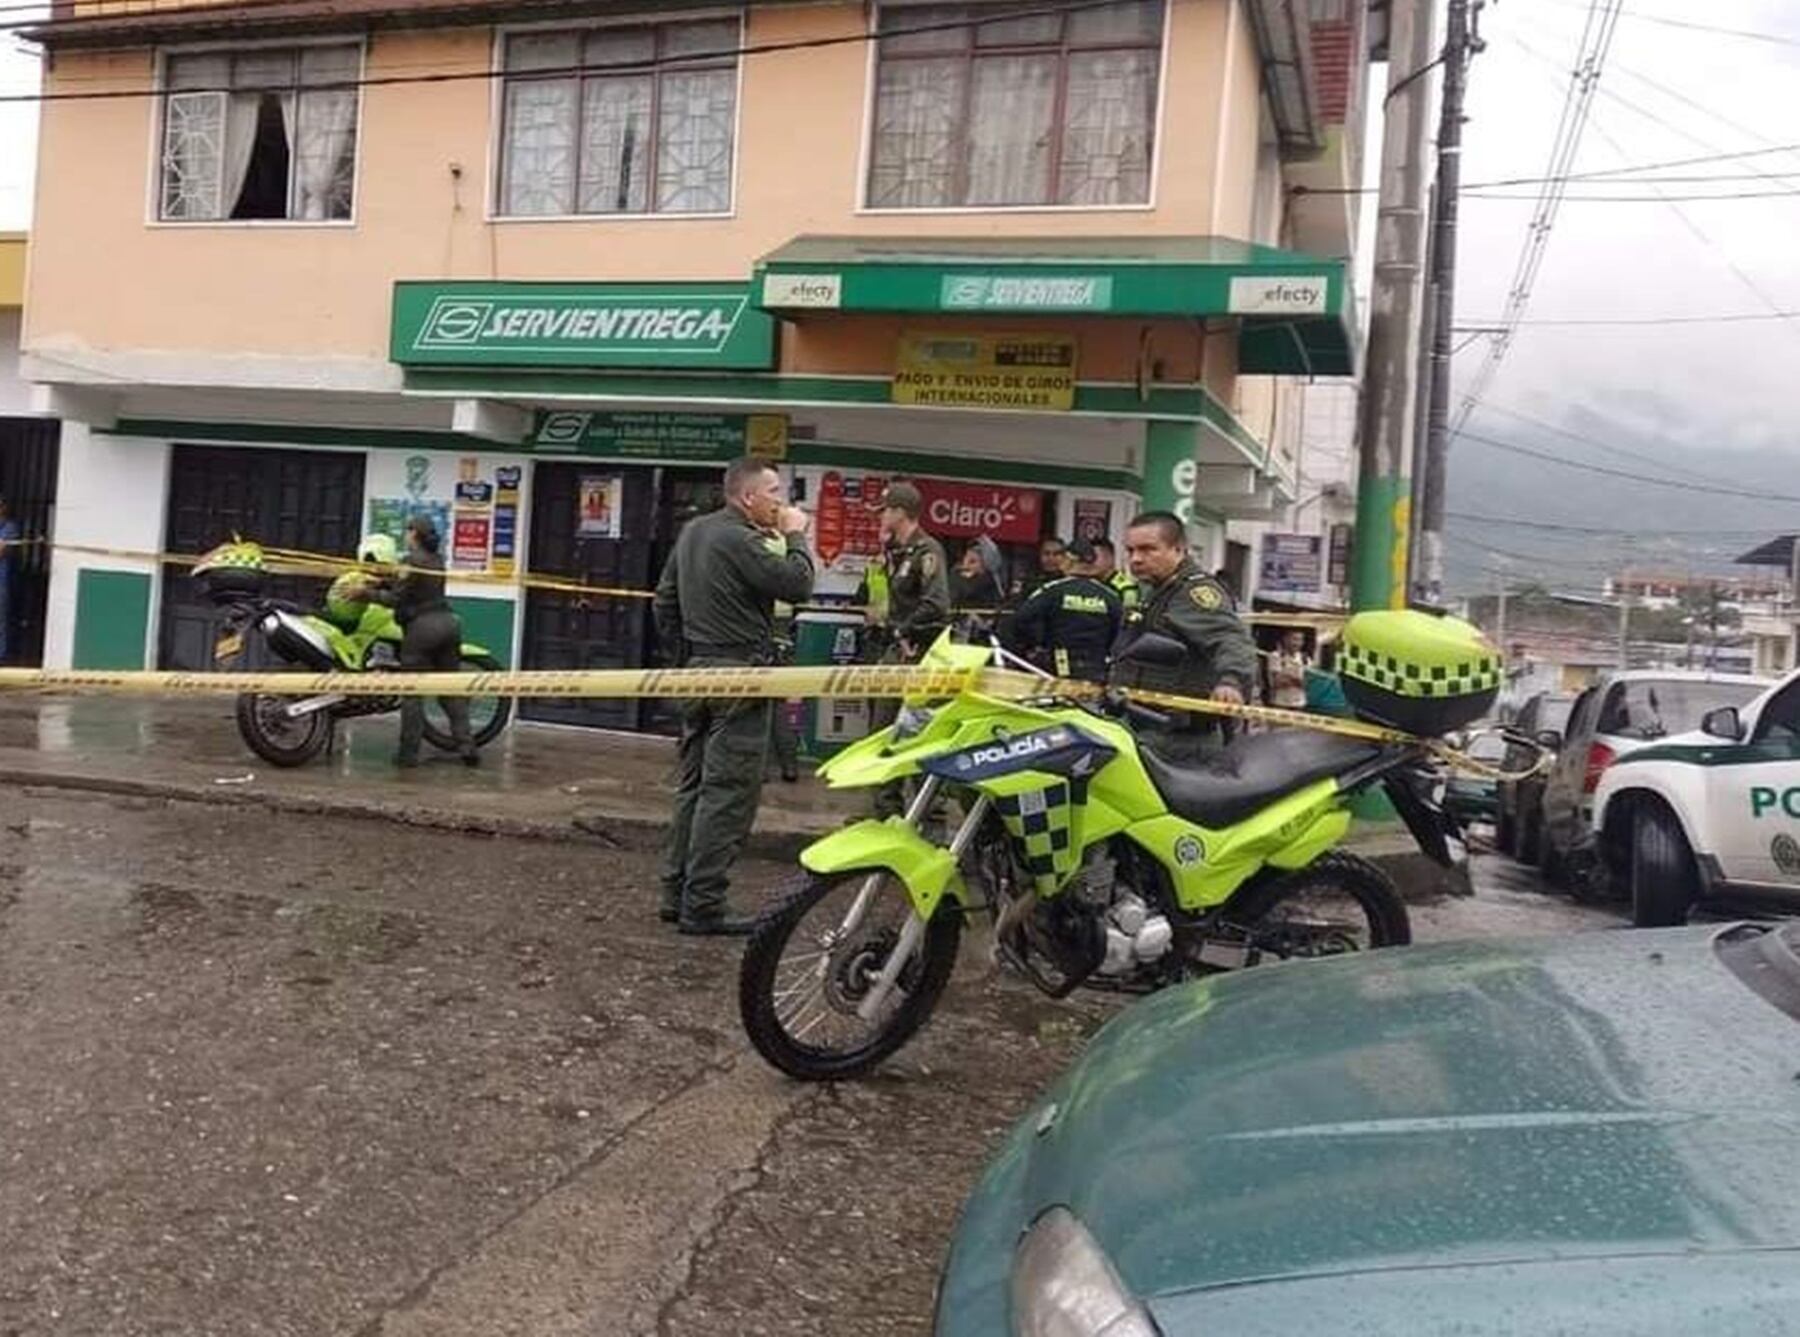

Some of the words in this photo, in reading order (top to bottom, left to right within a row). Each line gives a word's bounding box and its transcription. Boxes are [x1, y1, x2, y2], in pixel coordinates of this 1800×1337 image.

[790, 282, 834, 301] efecty
[1264, 284, 1320, 305] efecty
[481, 308, 722, 340] SERVIENTREGA
[1004, 375, 1024, 389] DE
[914, 389, 1050, 406] INTERNACIONALES
[930, 498, 1002, 528] Claro
[972, 735, 1049, 767] POLICÍA
